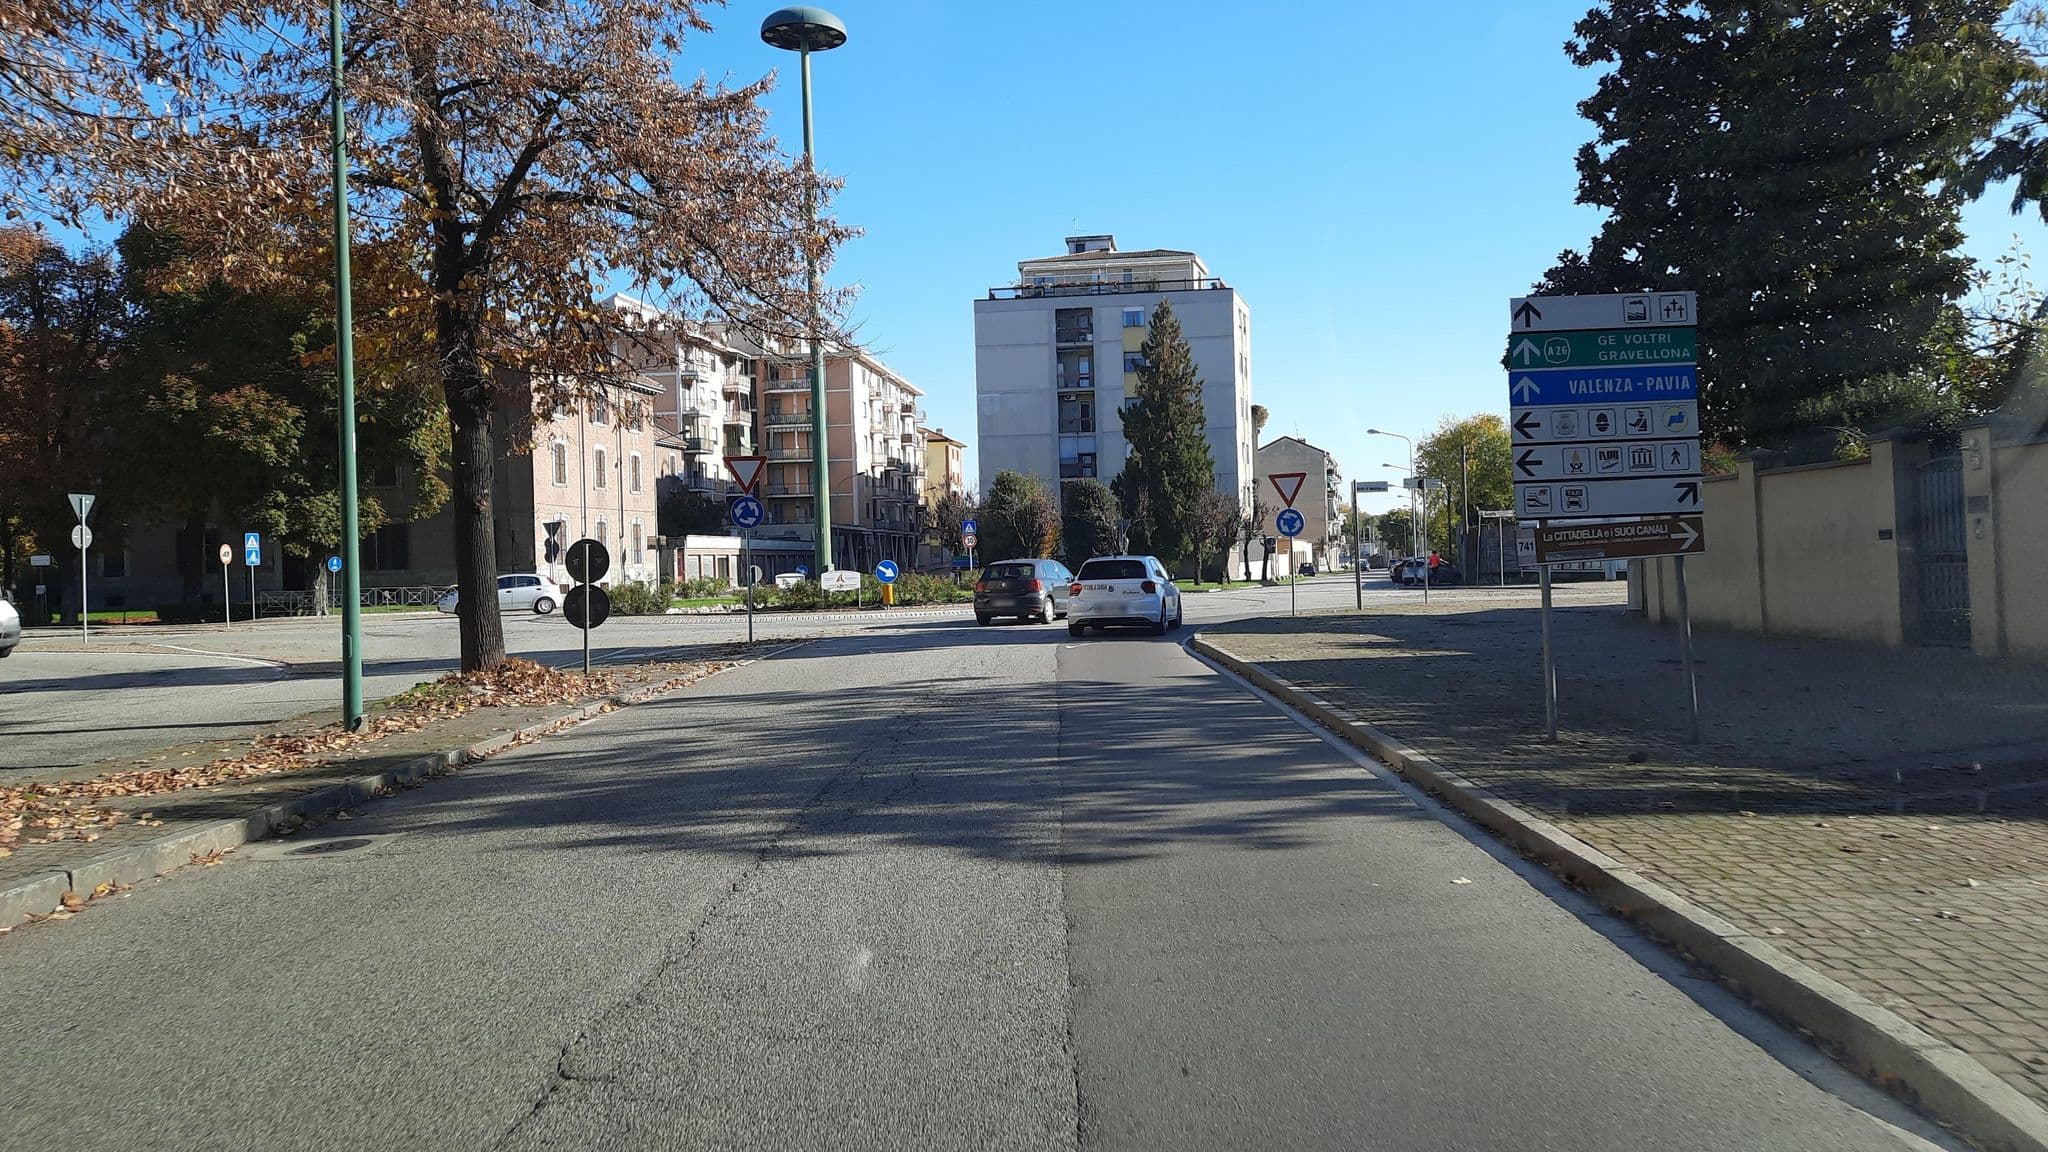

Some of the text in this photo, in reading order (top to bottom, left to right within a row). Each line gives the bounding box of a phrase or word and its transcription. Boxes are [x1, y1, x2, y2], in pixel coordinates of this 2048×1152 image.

[1598, 333, 1671, 345] GE VOLTRI
[1598, 348, 1690, 361] GRAVELLONA
[1569, 378, 1633, 394] VALENZA
[1646, 375, 1690, 391] PAVIA
[1542, 532, 1553, 542] La
[1553, 529, 1603, 541] CITTADELLA
[1614, 526, 1636, 537] SUOI
[1636, 524, 1668, 536] CANALI
[1518, 541, 1535, 552] 741
